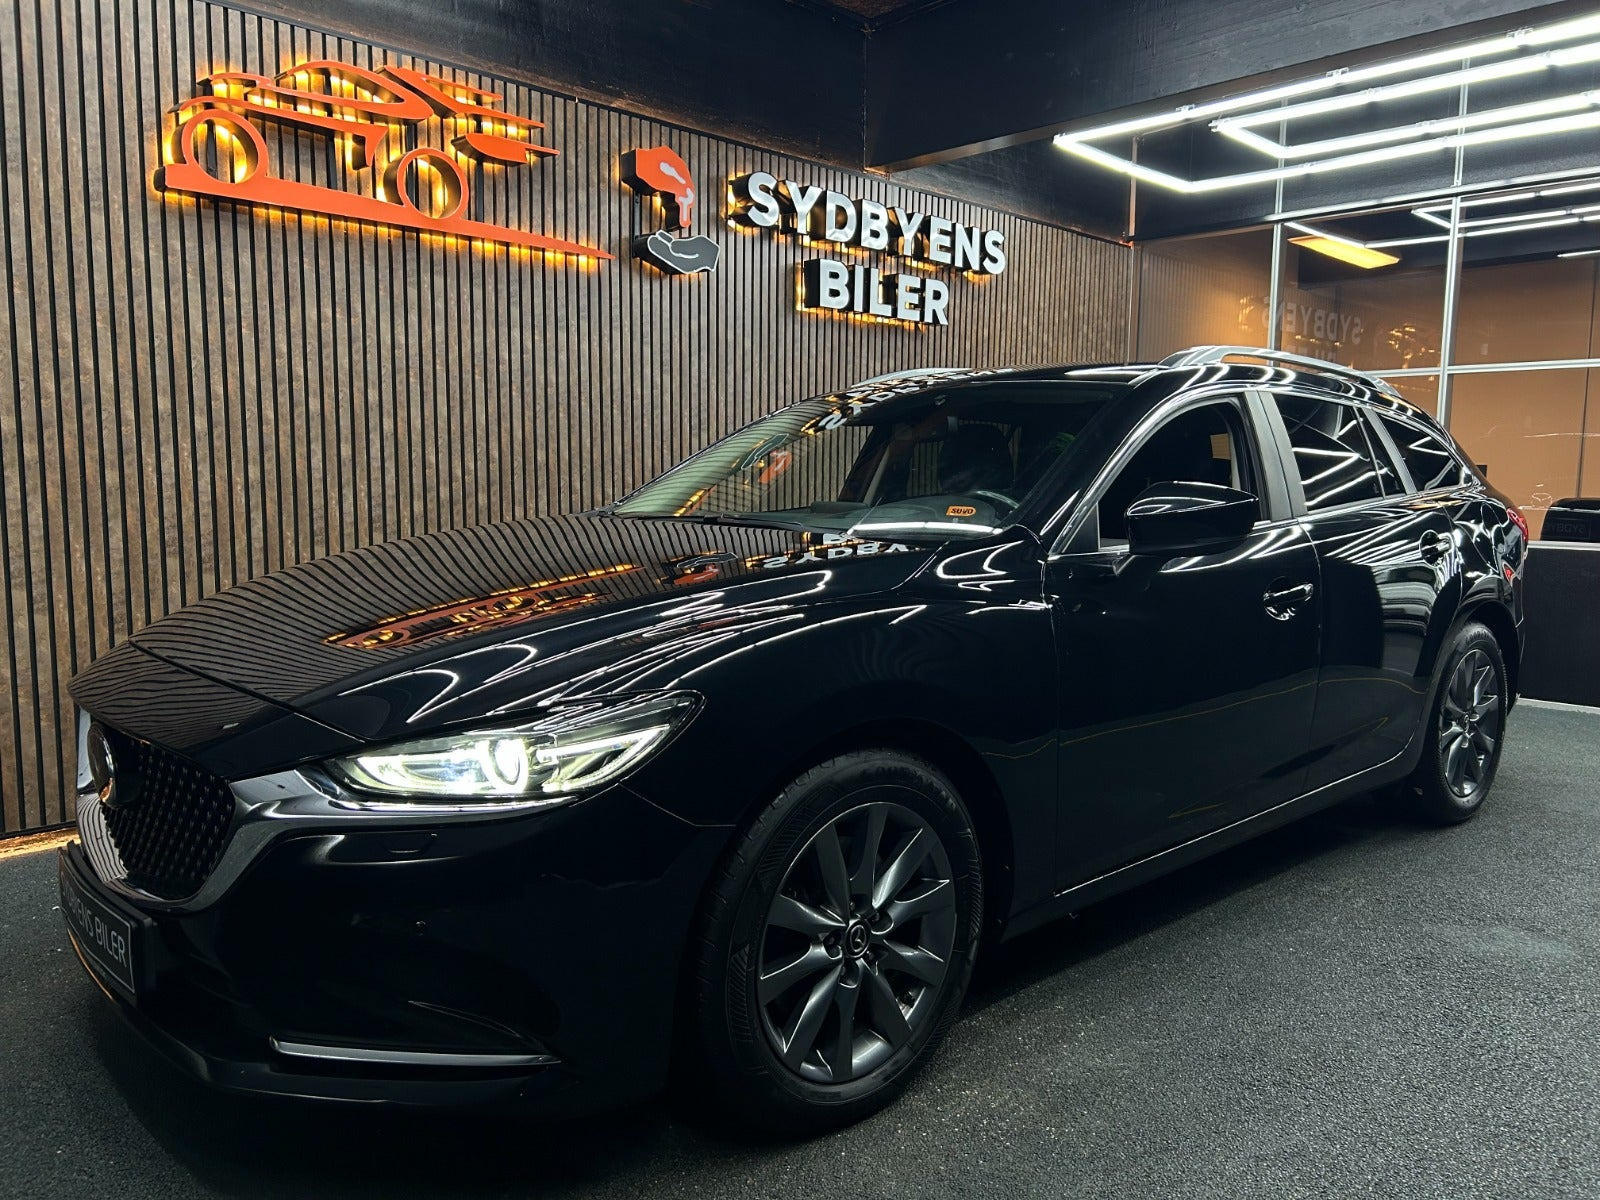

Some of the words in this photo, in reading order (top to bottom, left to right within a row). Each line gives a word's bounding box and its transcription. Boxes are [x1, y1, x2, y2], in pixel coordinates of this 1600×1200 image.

[748, 172, 1006, 275] SYDBYENS
[819, 258, 949, 326] BILER
[94, 916, 127, 968] BILER
